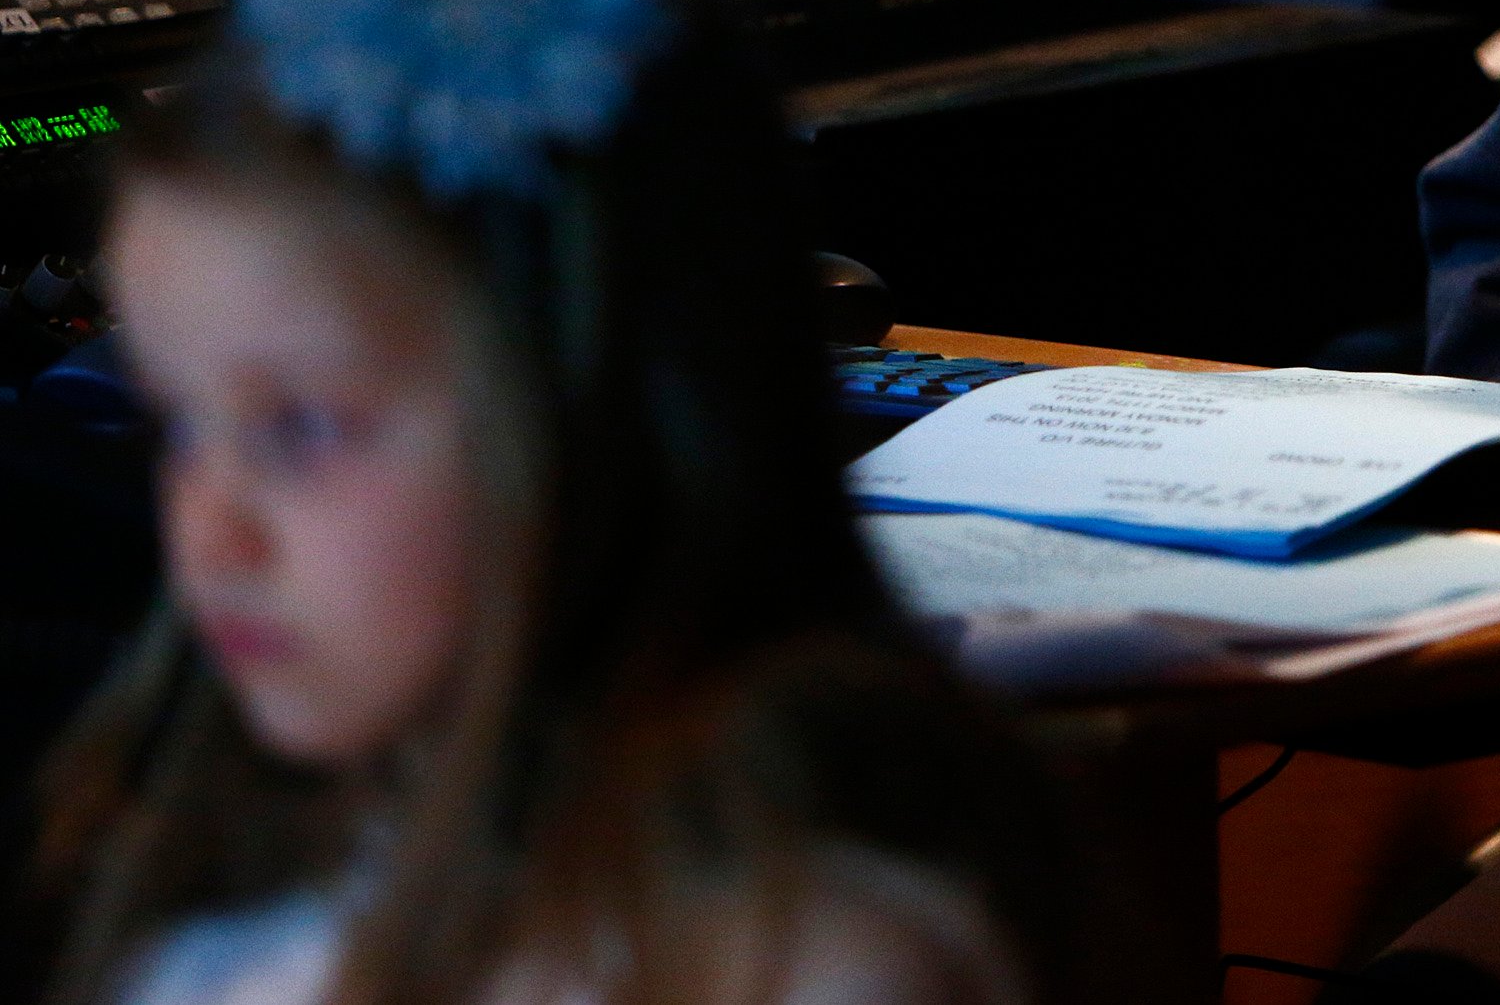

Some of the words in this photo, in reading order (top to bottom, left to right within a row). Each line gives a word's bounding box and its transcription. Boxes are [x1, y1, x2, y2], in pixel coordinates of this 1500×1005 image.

[1028, 403, 1121, 418] MORNING
[985, 413, 1030, 425] THIS
[1031, 417, 1064, 428] ON
[1122, 412, 1208, 426] MONDAY
[1063, 420, 1113, 433] NOW
